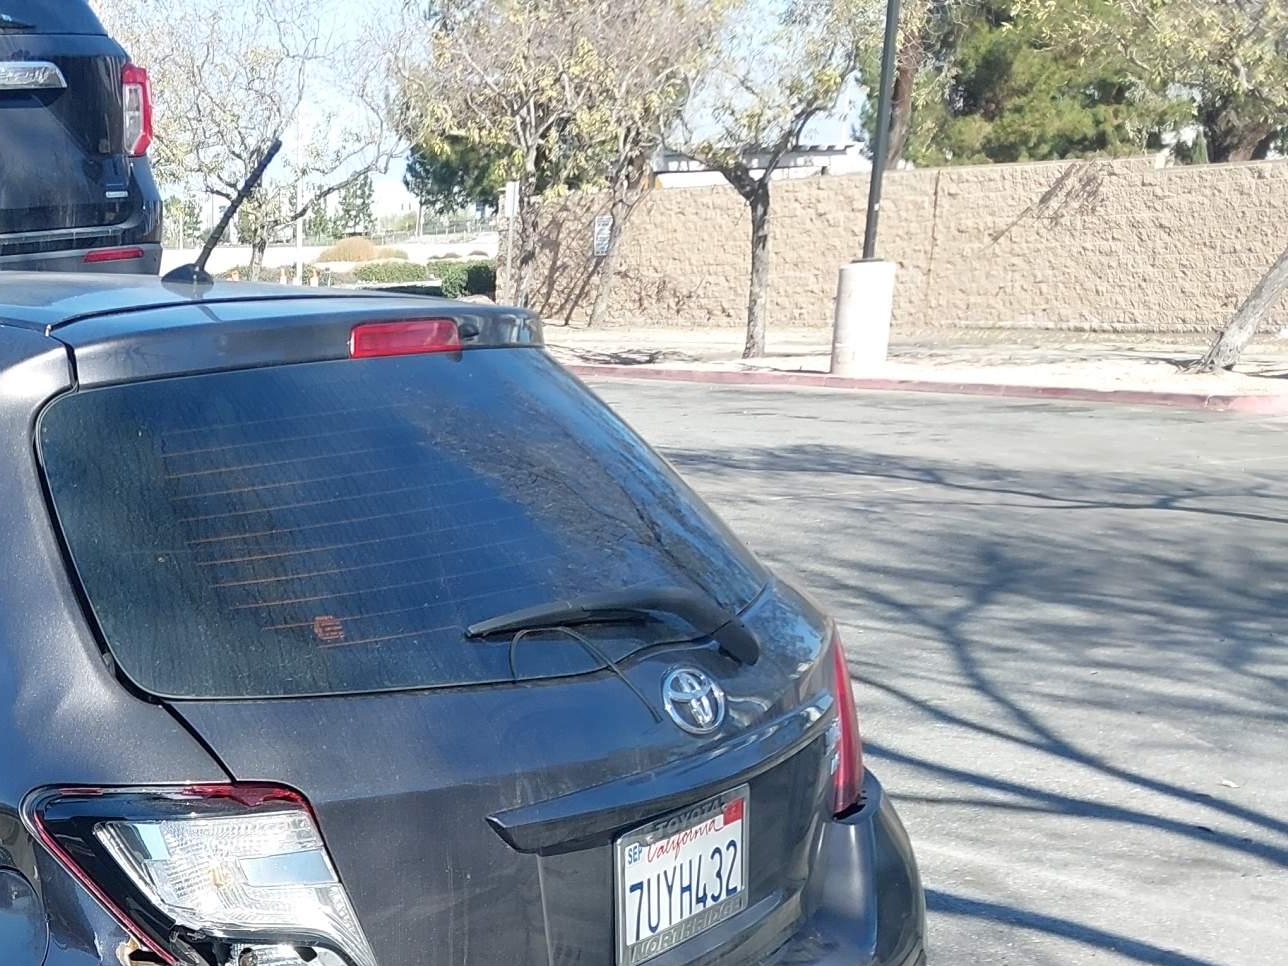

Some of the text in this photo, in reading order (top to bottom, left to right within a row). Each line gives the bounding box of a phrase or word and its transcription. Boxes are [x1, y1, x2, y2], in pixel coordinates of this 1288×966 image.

[655, 799, 722, 836] TOYOTA
[647, 818, 724, 863] California
[629, 839, 739, 942] 7UYH432
